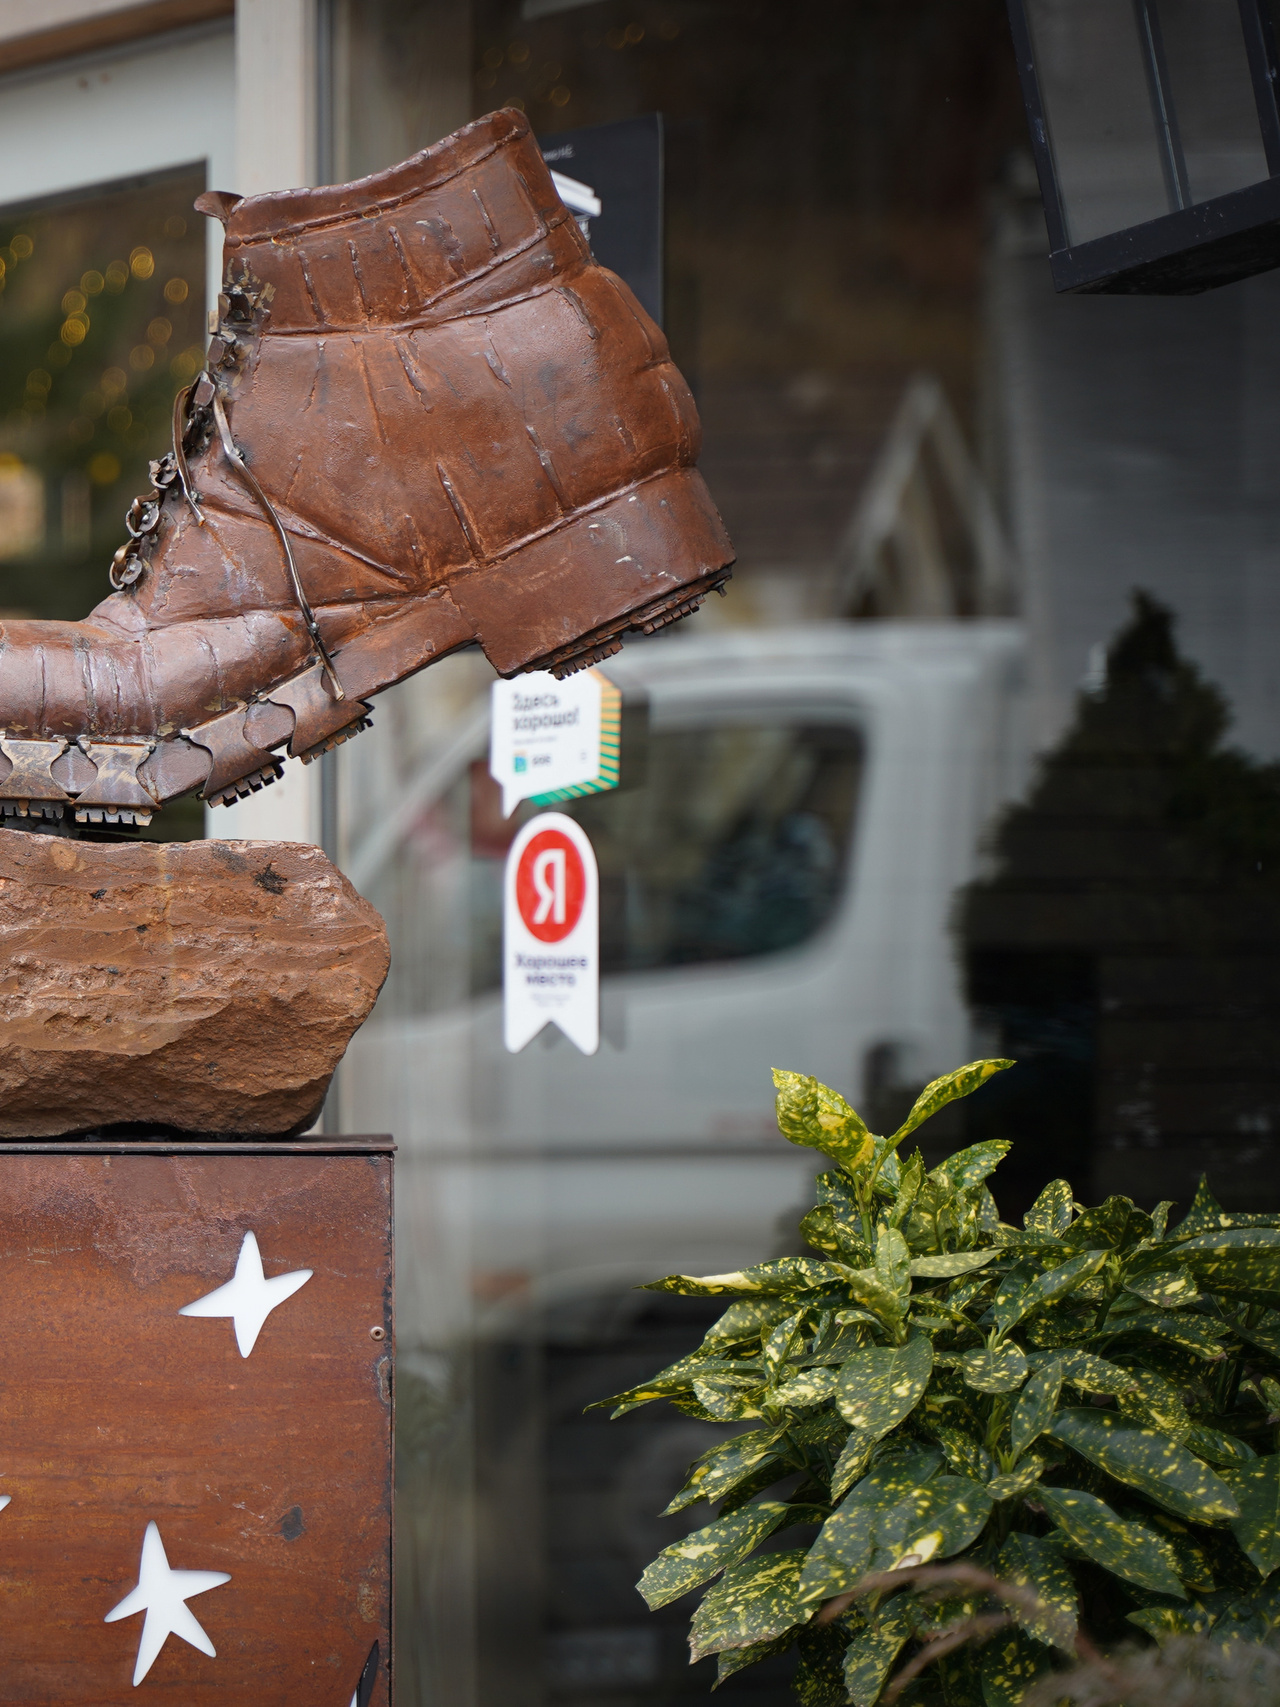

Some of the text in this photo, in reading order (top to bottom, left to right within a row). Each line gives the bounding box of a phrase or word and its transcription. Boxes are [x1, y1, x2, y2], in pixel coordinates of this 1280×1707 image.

[513, 693, 558, 711] Здесь
[513, 706, 579, 732] хорошо!
[533, 848, 566, 925] Я
[515, 952, 588, 970] Хорошее
[526, 975, 576, 987] место
